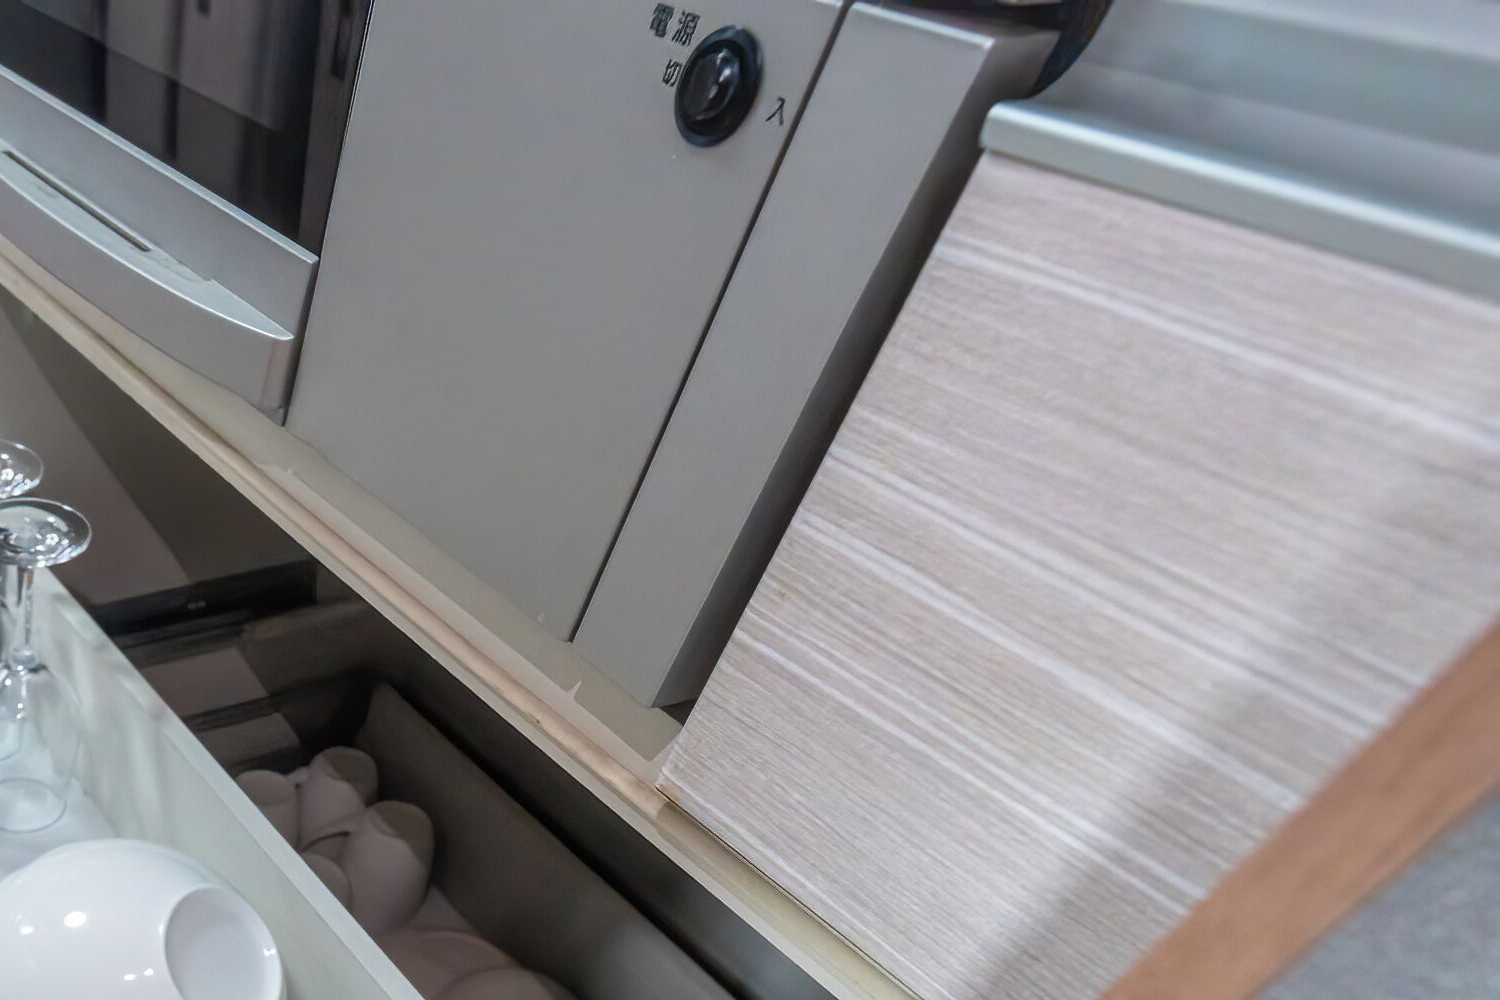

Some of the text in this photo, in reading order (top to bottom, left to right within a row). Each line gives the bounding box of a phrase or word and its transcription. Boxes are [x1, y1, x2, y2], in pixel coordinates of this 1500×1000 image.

[650, 3, 700, 47] 電源
[662, 59, 682, 87] 切
[765, 97, 786, 126] 入
